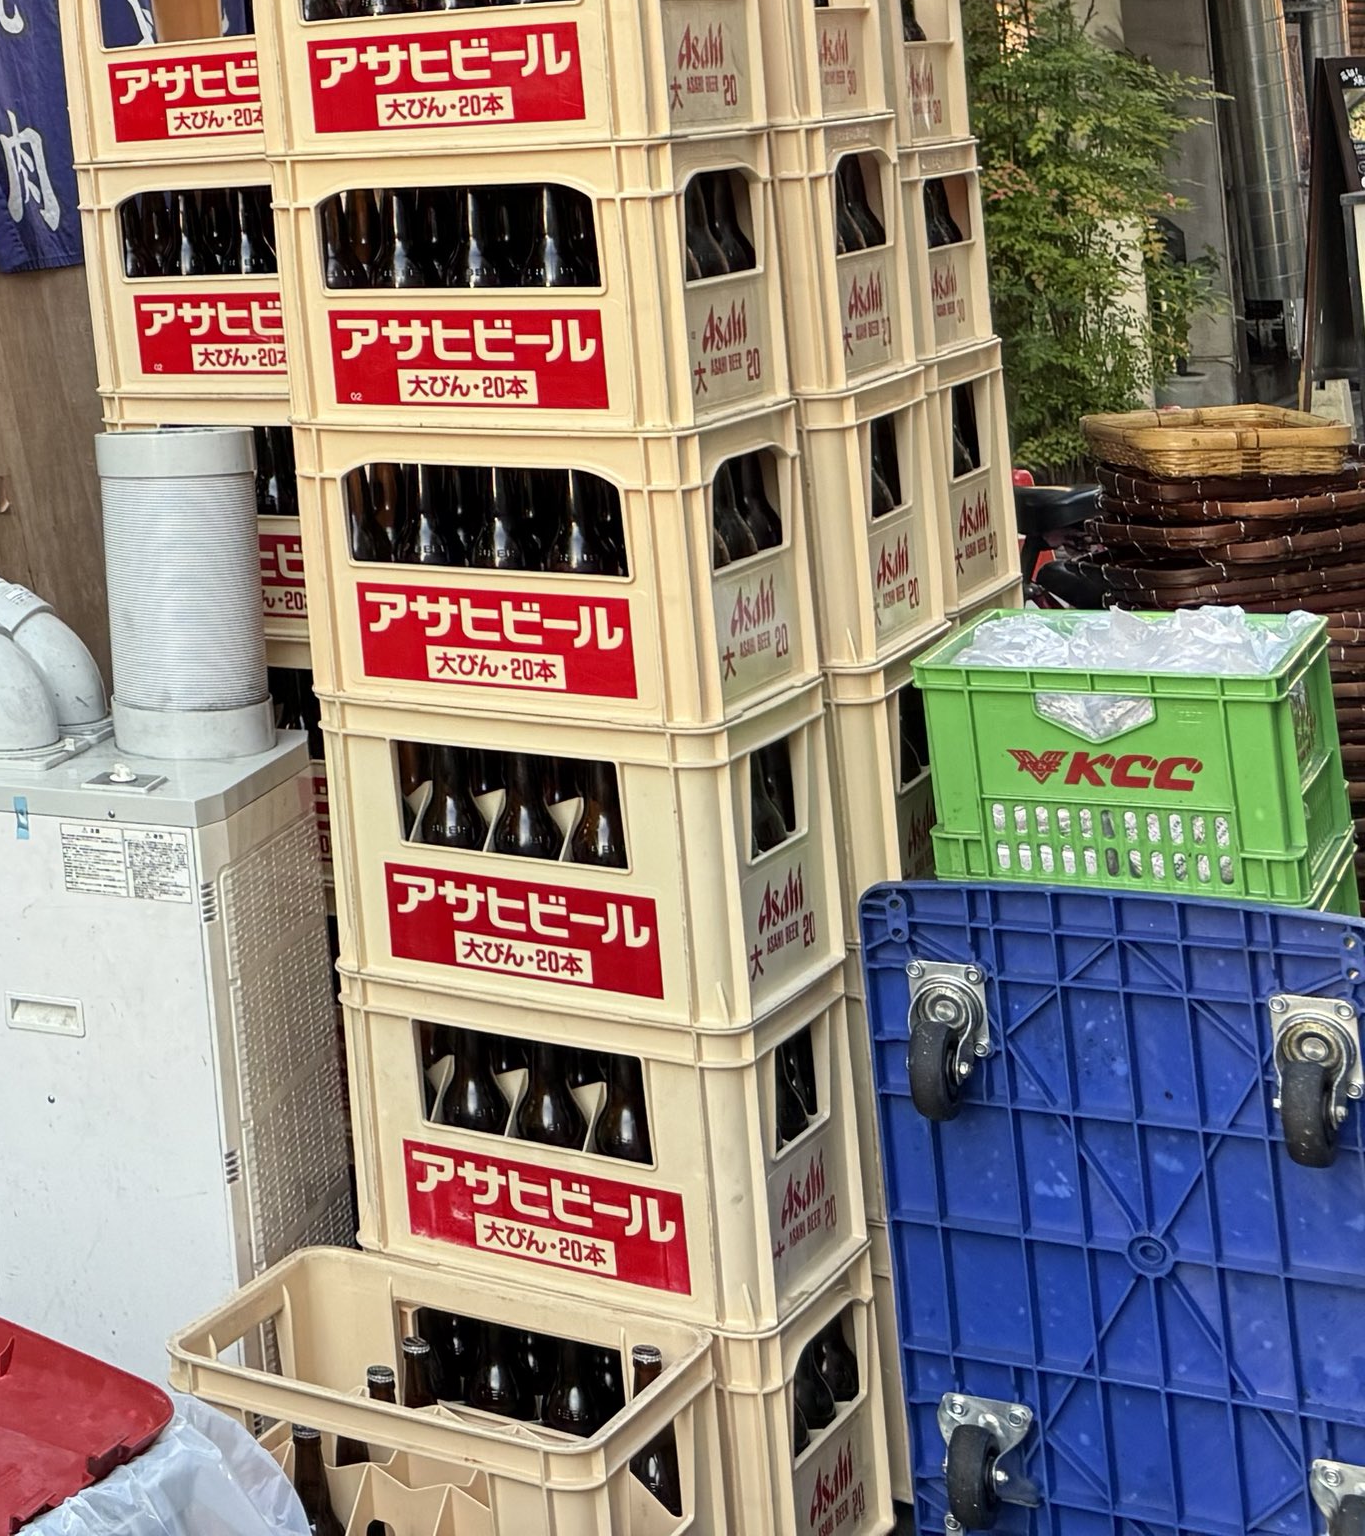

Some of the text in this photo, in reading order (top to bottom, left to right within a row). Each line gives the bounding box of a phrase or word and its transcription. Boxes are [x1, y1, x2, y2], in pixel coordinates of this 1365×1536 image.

[316, 33, 571, 89] アサヒビール
[678, 22, 723, 70] Asahi
[384, 91, 504, 121] 大びん・20本
[670, 76, 683, 110] 大
[723, 74, 737, 105] 20
[336, 319, 596, 363] アサヒビール
[702, 298, 747, 354] Asahi
[407, 374, 529, 399] 大びん・20本
[694, 361, 708, 395] 大
[746, 348, 761, 381] 20
[959, 488, 989, 541] Asahi
[876, 532, 909, 590] Asahi
[365, 591, 624, 651] アサヒビール
[731, 574, 775, 638] Asahi
[874, 598, 881, 626] 大
[908, 577, 919, 609] 20
[435, 652, 557, 683] 大びん・20本
[722, 646, 737, 682] 大
[775, 623, 789, 658] 20
[1064, 751, 1203, 791] KCC
[393, 873, 650, 948] アサヒビール
[758, 862, 804, 935] Asahi
[462, 938, 584, 977] 大びん・20本
[750, 944, 764, 982] 大
[803, 911, 816, 948] 20
[412, 1150, 676, 1243] アサヒビール
[781, 1147, 825, 1230] Asahi
[825, 1194, 837, 1231] 20
[483, 1221, 607, 1267] 大びん・20本
[810, 1437, 853, 1528] Asahi
